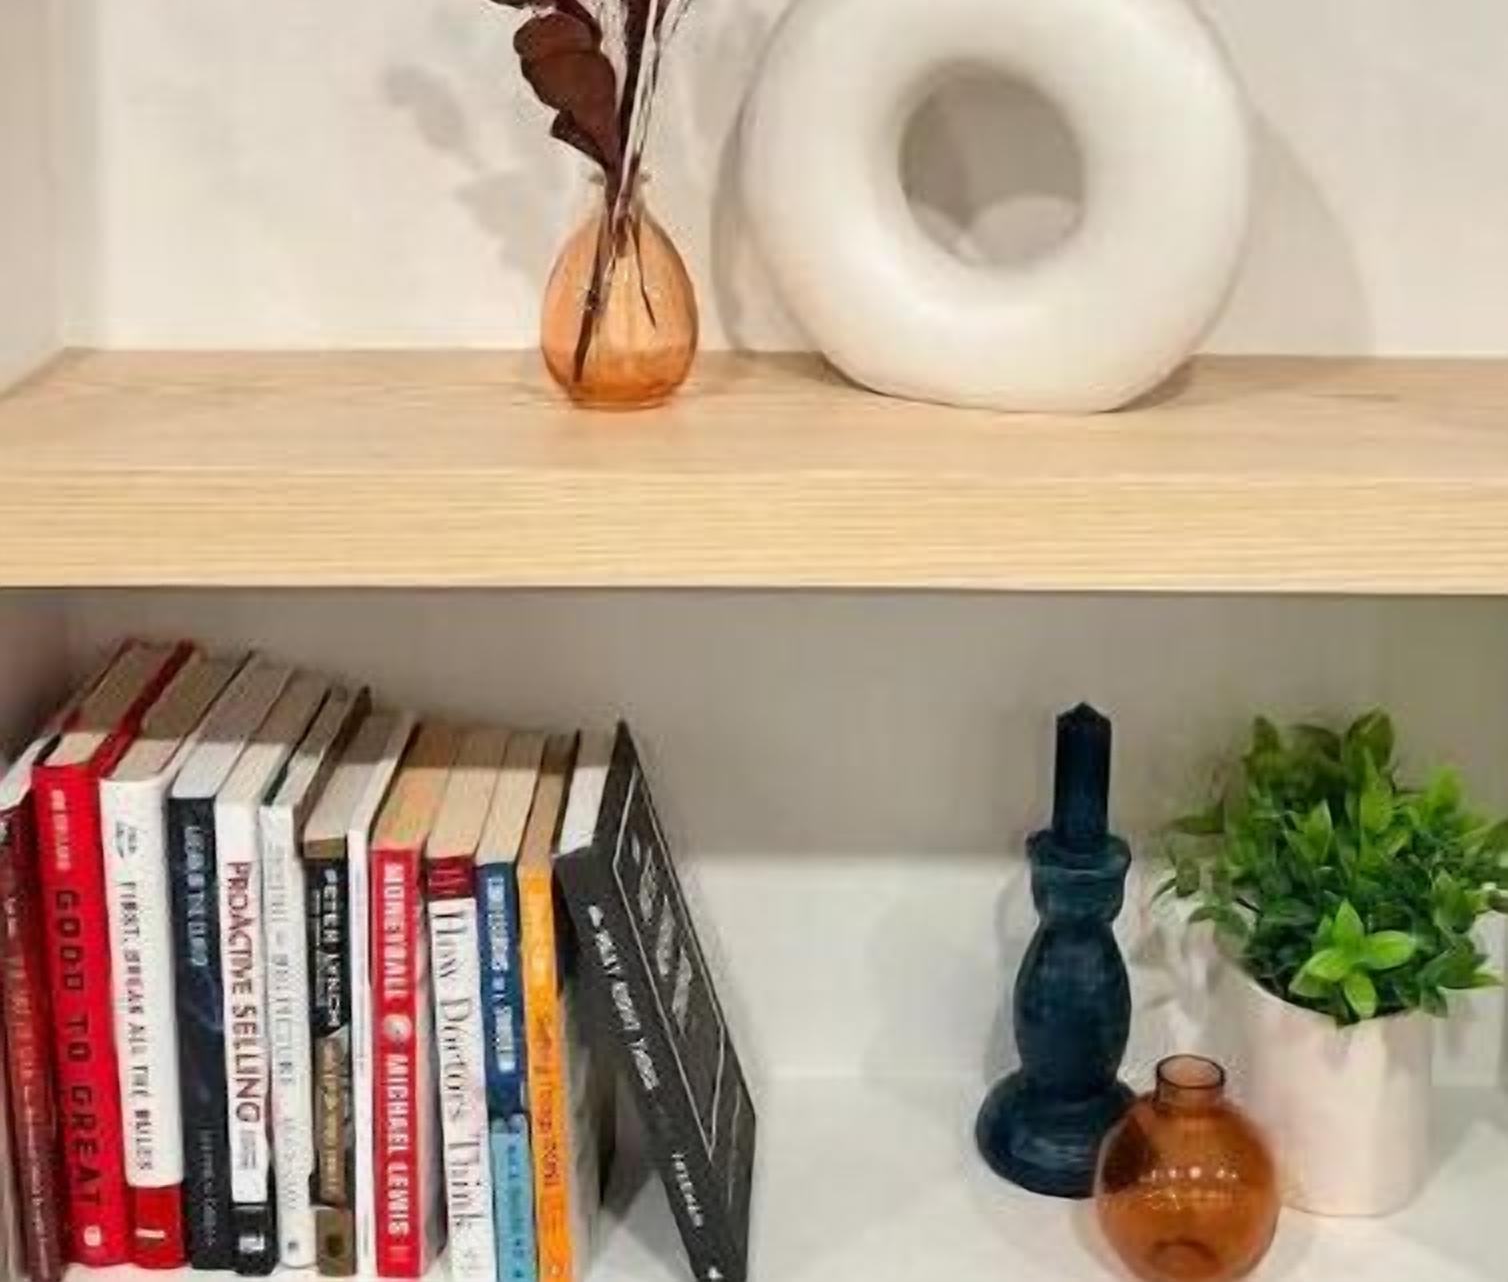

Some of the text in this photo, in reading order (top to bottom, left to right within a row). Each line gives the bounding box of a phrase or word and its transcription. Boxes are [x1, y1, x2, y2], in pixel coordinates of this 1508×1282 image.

[56, 889, 86, 991] GOOD
[64, 1014, 92, 1062] TO
[231, 1004, 261, 1124] SELLING
[383, 862, 410, 1236] MONEYBALL MICHAEL LEWIS
[71, 1086, 101, 1204] GREAT
